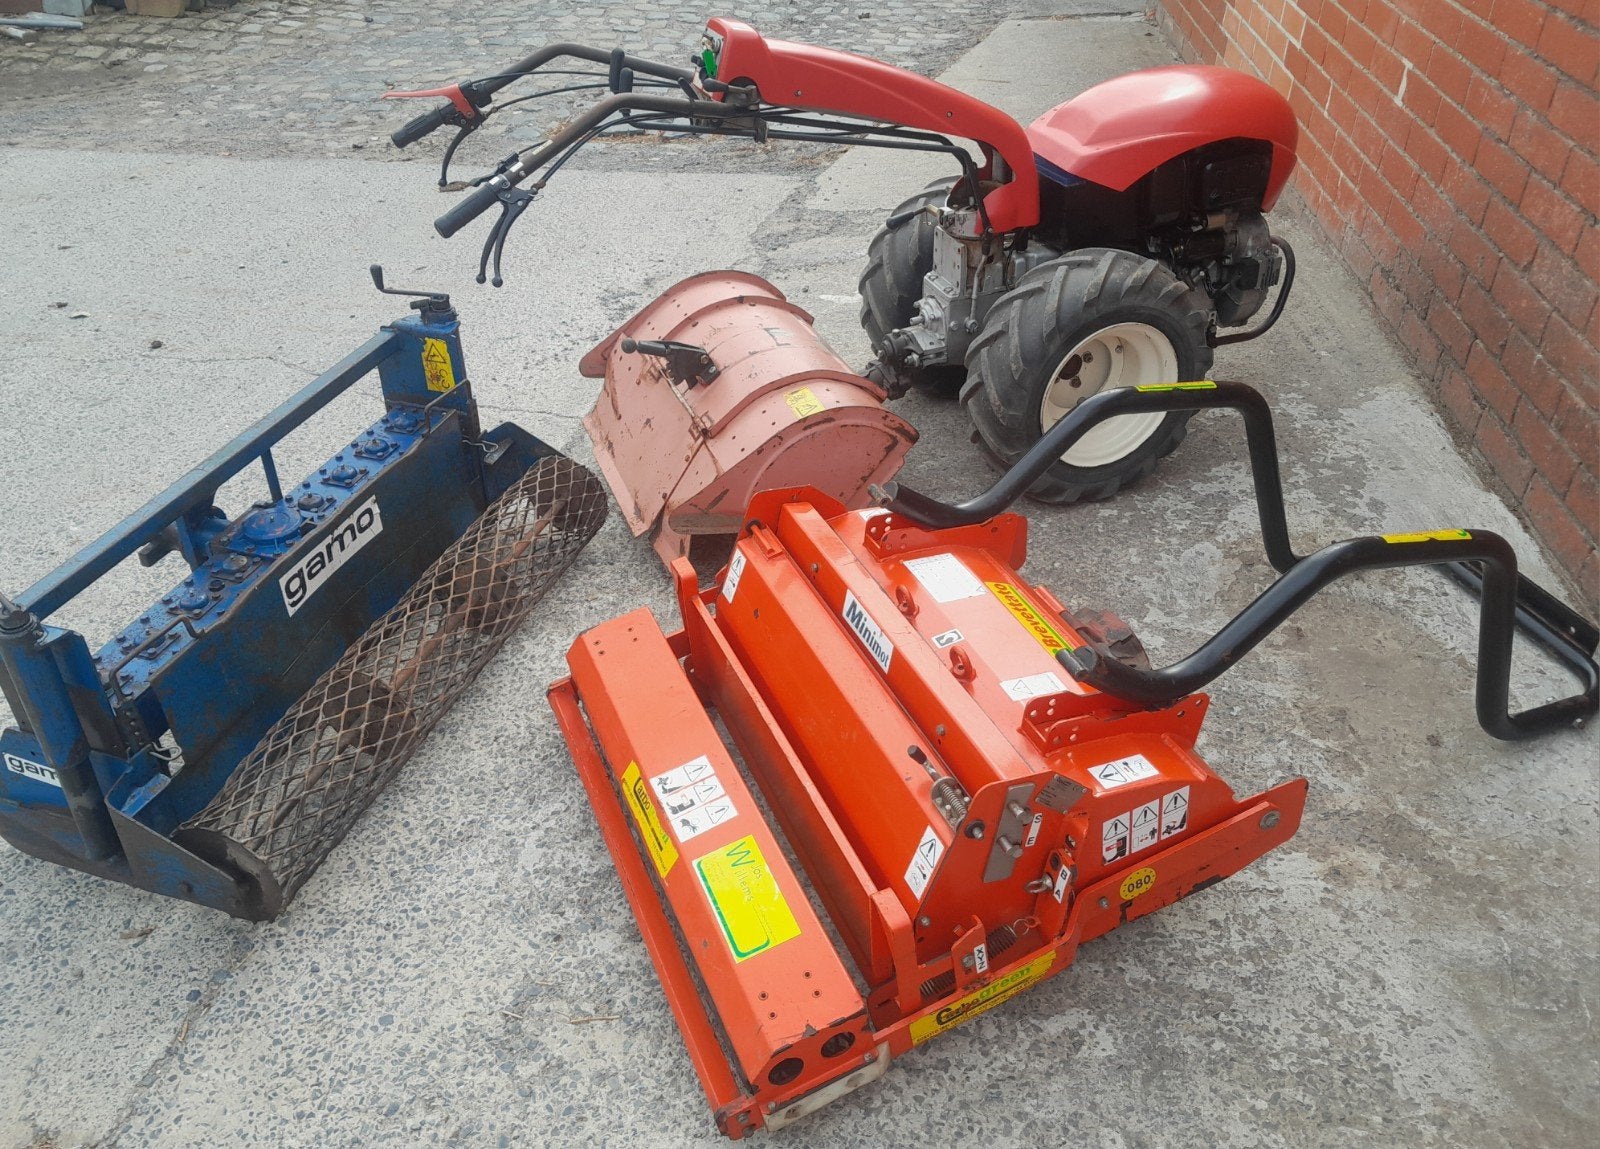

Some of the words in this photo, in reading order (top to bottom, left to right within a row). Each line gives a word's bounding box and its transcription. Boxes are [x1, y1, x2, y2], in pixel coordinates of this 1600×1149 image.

[284, 507, 375, 608] gamo
[993, 583, 1063, 648] Brevettato
[845, 600, 889, 668] Minimot
[1034, 814, 1042, 824] S
[1027, 836, 1035, 846] E
[1060, 869, 1068, 881] B
[1127, 874, 1151, 893] 080
